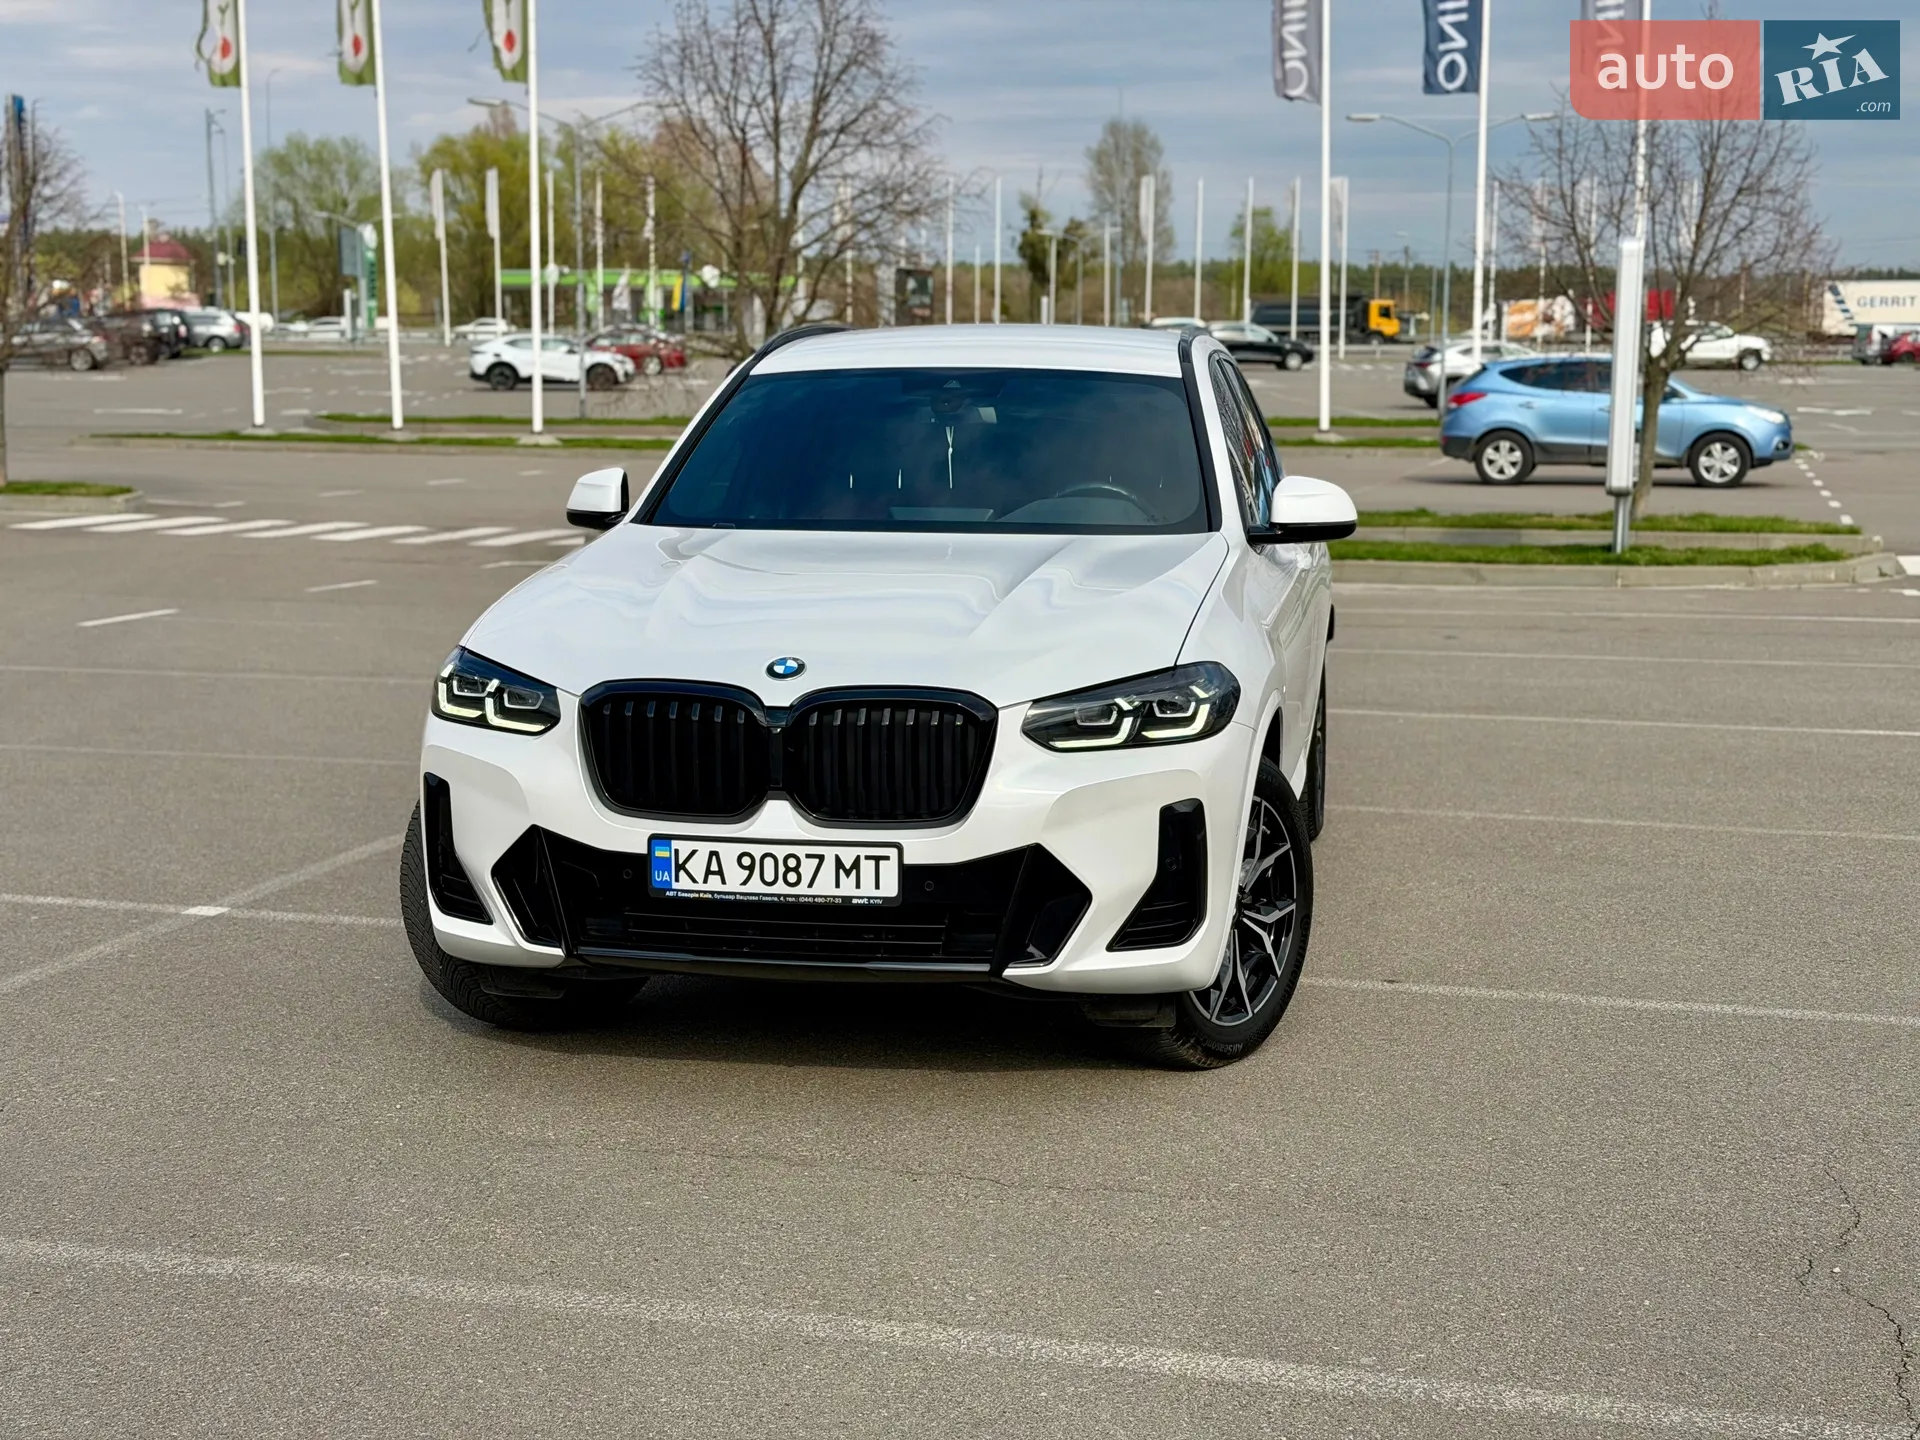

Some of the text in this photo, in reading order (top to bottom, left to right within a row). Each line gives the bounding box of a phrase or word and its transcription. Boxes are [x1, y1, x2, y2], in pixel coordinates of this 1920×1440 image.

[1857, 295, 1917, 307] GERRIT
[674, 848, 891, 891] KA 9087 MT
[655, 870, 671, 882] UA
